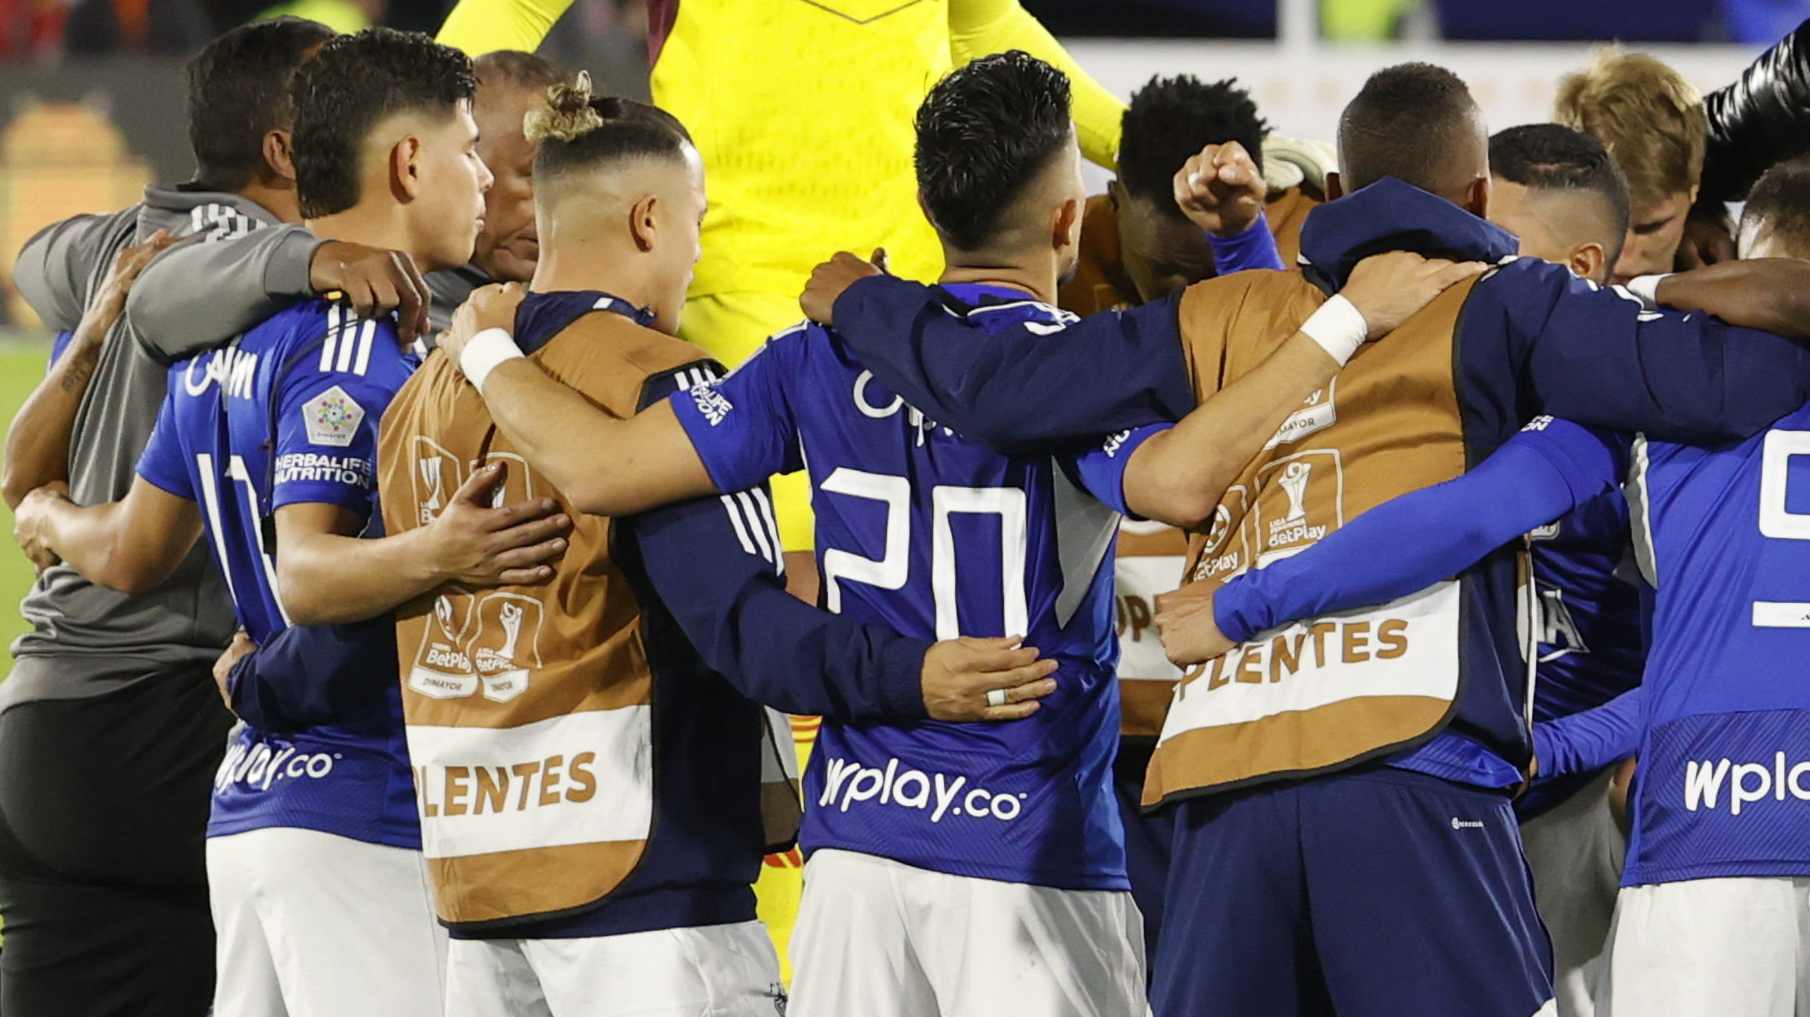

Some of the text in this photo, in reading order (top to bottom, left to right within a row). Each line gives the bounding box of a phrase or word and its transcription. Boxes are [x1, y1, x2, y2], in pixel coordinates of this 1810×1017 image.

[276, 452, 372, 475] HERBALIFE
[274, 467, 370, 489] NUTRITION
[820, 466, 1029, 652] 20
[1193, 551, 1239, 582] etPlay
[426, 649, 472, 674] BetPlay
[819, 758, 1022, 823] Wplay.co
